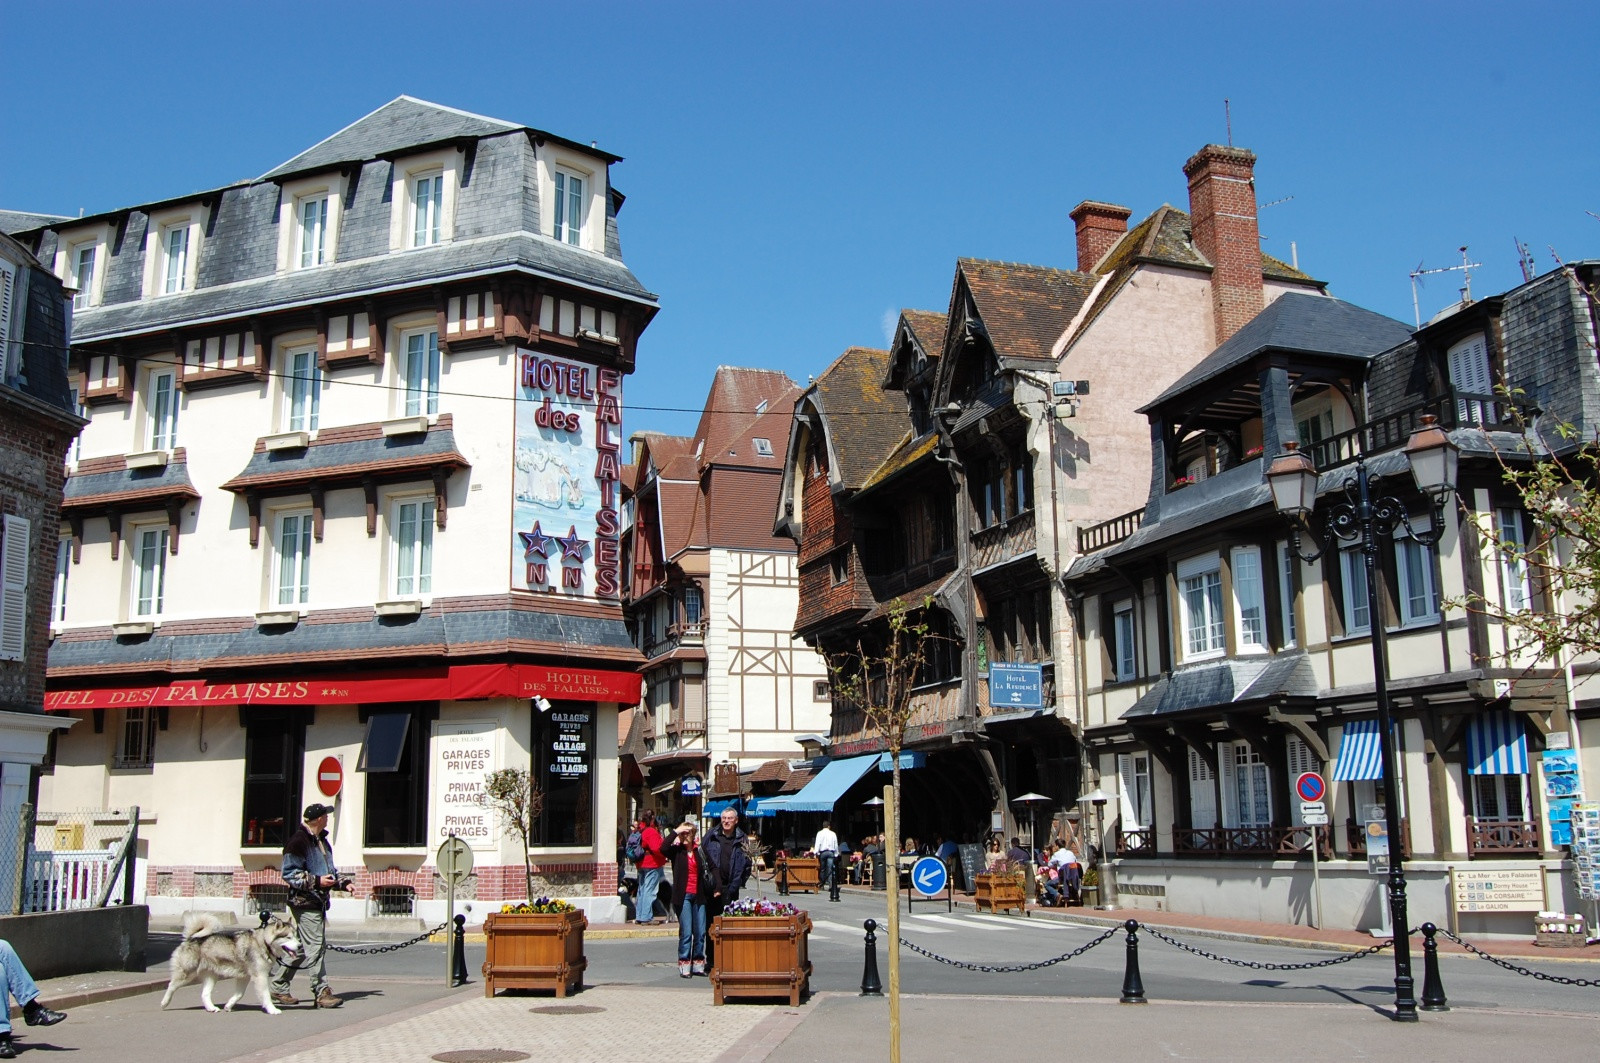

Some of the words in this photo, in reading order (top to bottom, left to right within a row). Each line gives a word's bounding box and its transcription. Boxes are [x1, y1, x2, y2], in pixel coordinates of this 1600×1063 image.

[521, 353, 594, 400] HOTEL
[535, 397, 581, 433] des
[595, 365, 620, 597] FALAISES
[546, 672, 602, 685] HOTEL
[108, 689, 153, 704] DES
[164, 682, 309, 701] FALAISES
[523, 682, 547, 691] DES
[554, 684, 609, 695] FALAISES
[551, 713, 589, 722] GARAGES
[553, 742, 587, 751] GARAGE
[442, 749, 490, 760] GARAGES
[447, 760, 484, 770] PRIVES
[550, 764, 588, 773] GARAGES
[448, 782, 482, 792] PRIVAT
[444, 793, 486, 803] GARAGE
[445, 815, 484, 825] PRIVATE
[440, 826, 488, 837] GARAGES
